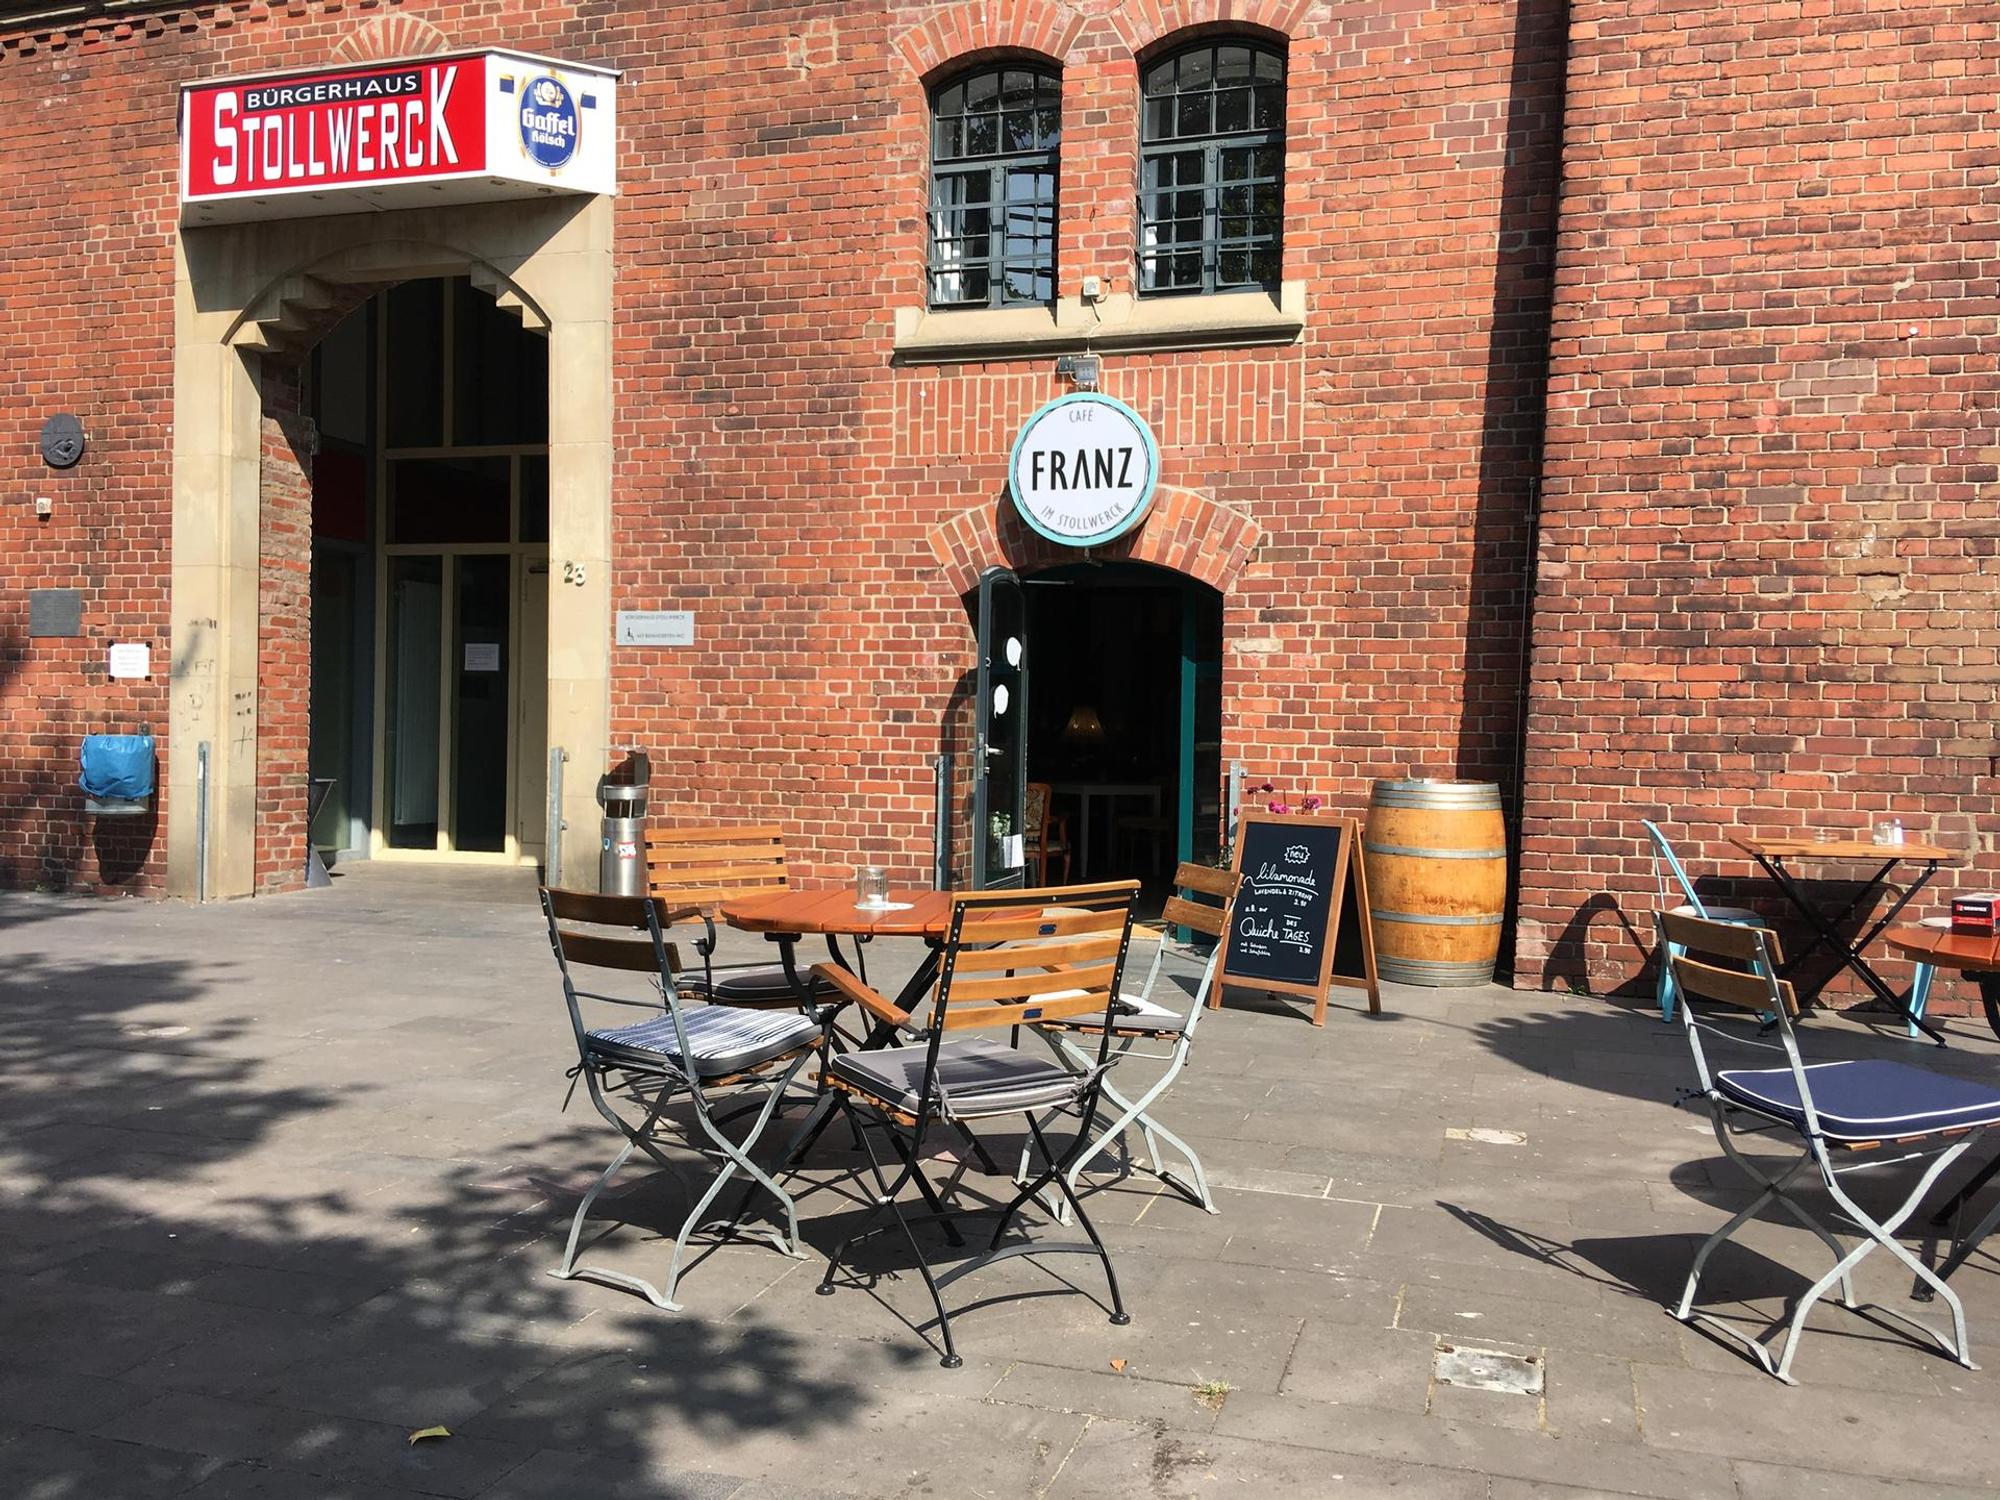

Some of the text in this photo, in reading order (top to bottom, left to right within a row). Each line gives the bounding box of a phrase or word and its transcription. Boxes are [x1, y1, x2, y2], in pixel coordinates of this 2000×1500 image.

[247, 75, 418, 109] BÜRGERHAUS
[213, 65, 460, 185] STOLLWERCK
[522, 107, 576, 136] Gaffel
[531, 130, 566, 149] Kölsch
[1068, 406, 1095, 423] CAFÉ
[1031, 447, 1133, 491] FRANZ
[1041, 502, 1125, 530] IM STOLLWERCK
[1289, 850, 1305, 860] neu
[1239, 916, 1311, 943] Quiche TAGES
